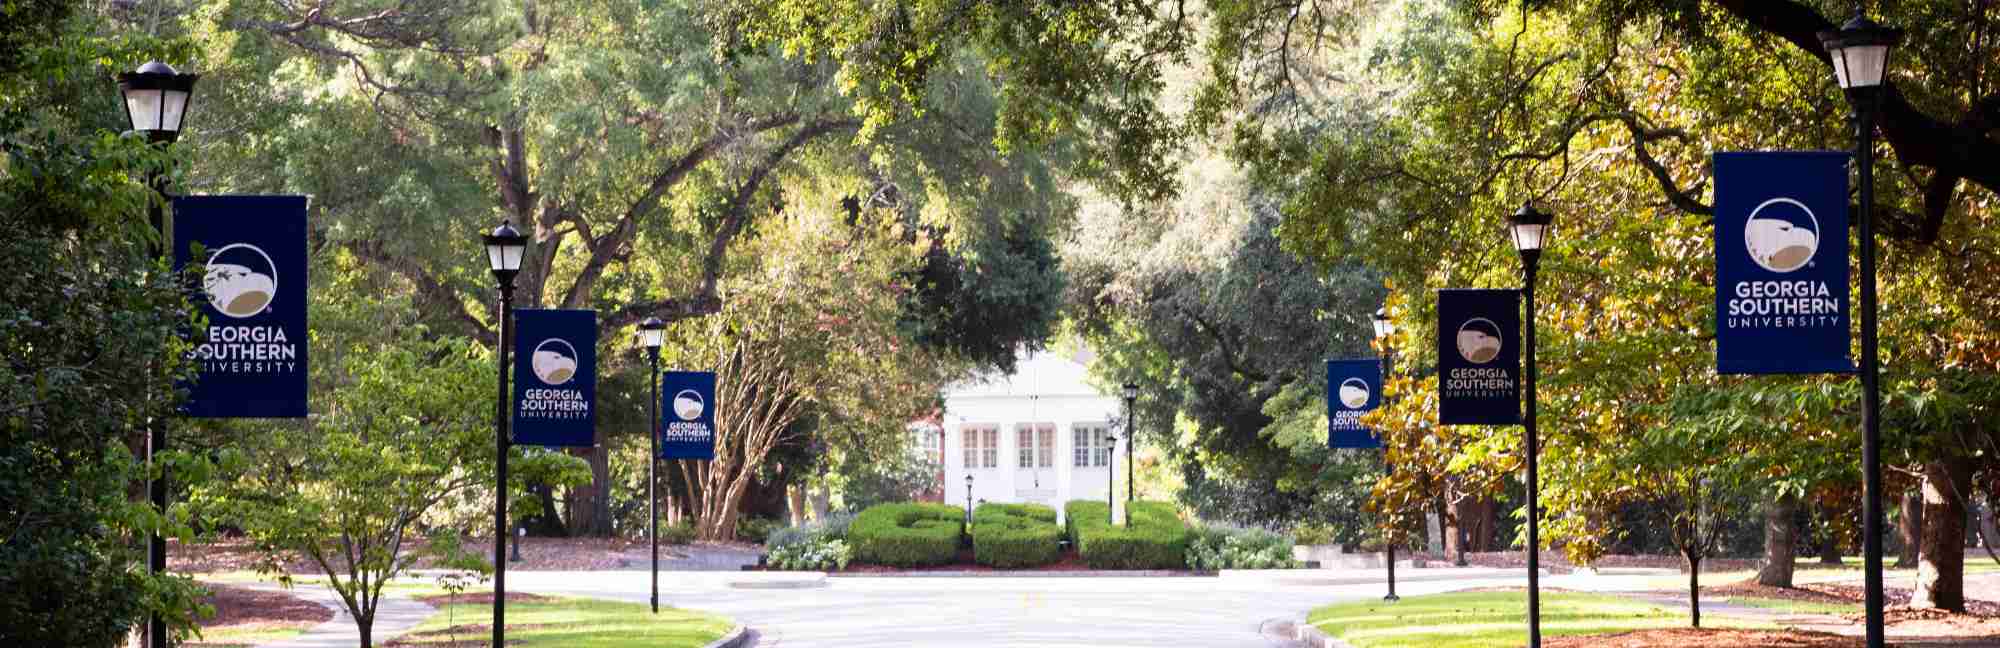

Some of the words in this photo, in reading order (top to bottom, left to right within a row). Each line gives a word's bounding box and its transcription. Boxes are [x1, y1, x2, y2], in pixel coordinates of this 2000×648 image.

[1735, 280, 1830, 298] GEORGIA
[1728, 297, 1839, 315] SOUTHERN
[1728, 316, 1839, 328] UNIVERSITY
[209, 326, 287, 342] EORGIA
[203, 361, 295, 373] IVERSITY
[1450, 368, 1508, 379] GEORGIA
[1446, 379, 1513, 390] SOUTHERN
[525, 389, 583, 400] GEORGIA
[521, 400, 588, 411] SOUTHERN
[669, 422, 707, 430] GEORGIA
